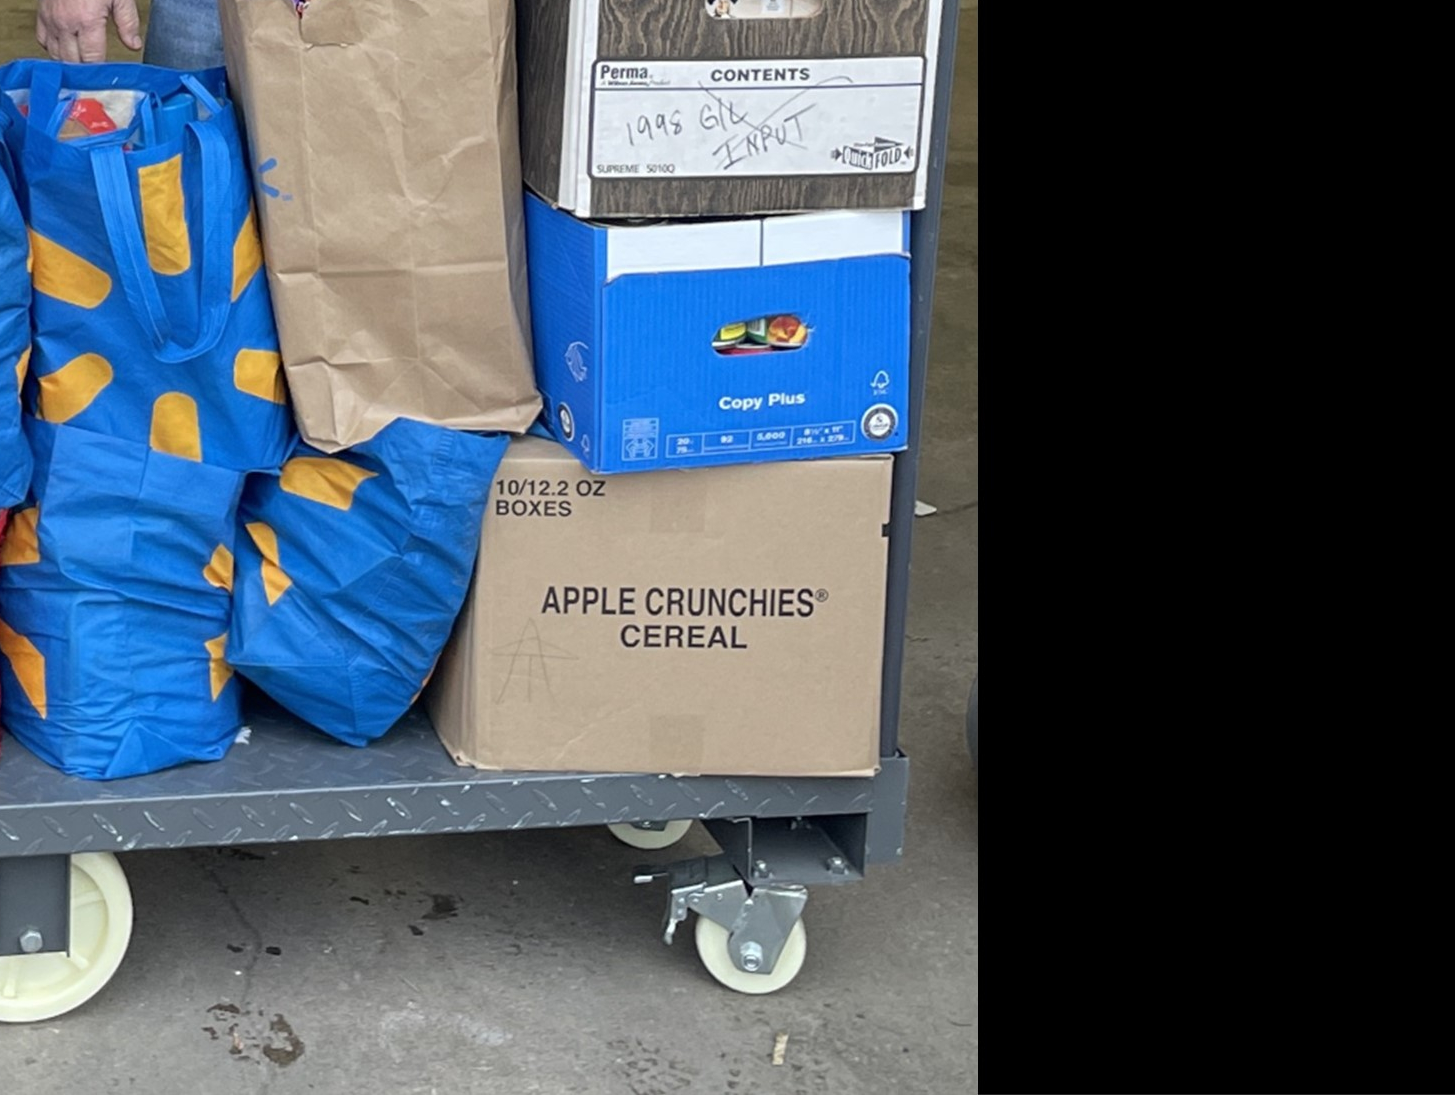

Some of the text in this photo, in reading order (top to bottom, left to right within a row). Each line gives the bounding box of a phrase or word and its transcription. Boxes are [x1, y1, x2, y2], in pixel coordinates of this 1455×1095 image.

[600, 65, 810, 82] Perma CONTENTS
[626, 109, 682, 146] 1998
[597, 164, 639, 174] SUPREME
[718, 393, 806, 412] Copy Plus
[496, 479, 606, 496] 10/12.2 OZ
[496, 499, 572, 517] BOXES
[541, 586, 636, 615] APPLE
[620, 624, 748, 649] CEREAL
